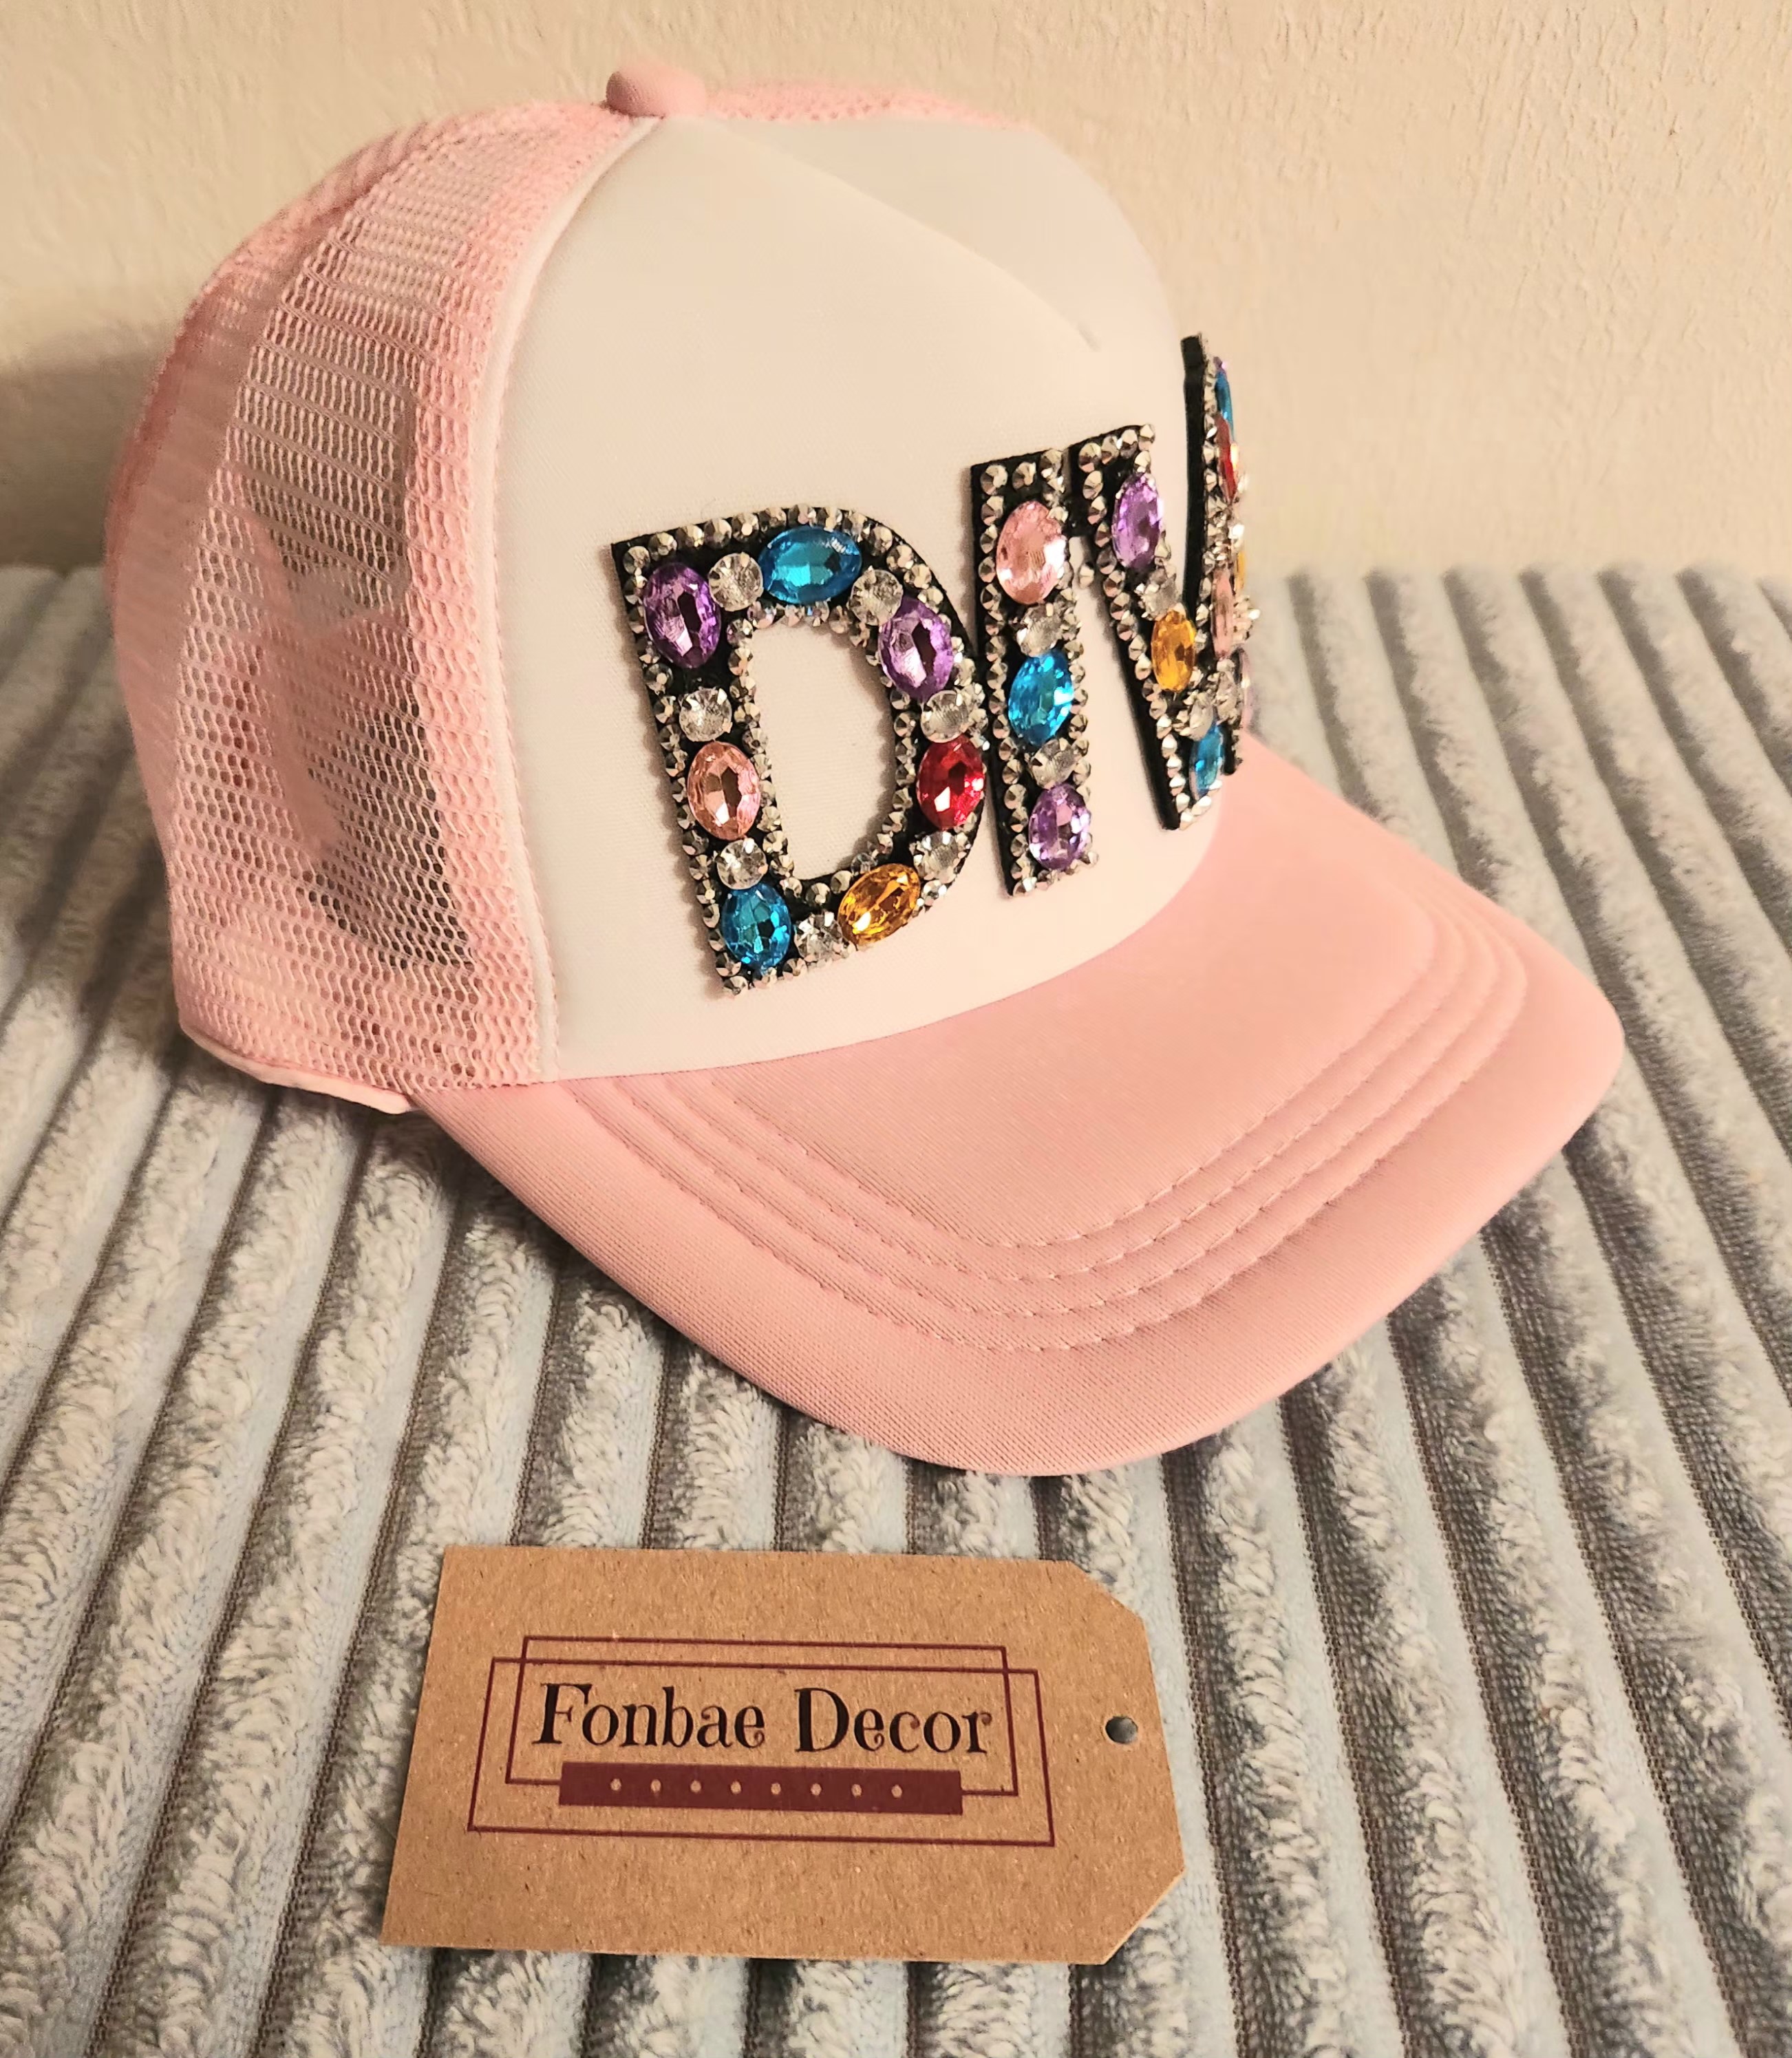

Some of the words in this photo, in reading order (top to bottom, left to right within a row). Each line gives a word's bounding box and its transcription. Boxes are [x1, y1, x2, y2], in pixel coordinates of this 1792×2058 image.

[611, 332, 1259, 997] DIV
[532, 1682, 766, 1749] Fonbae
[793, 1686, 993, 1754] Decor
